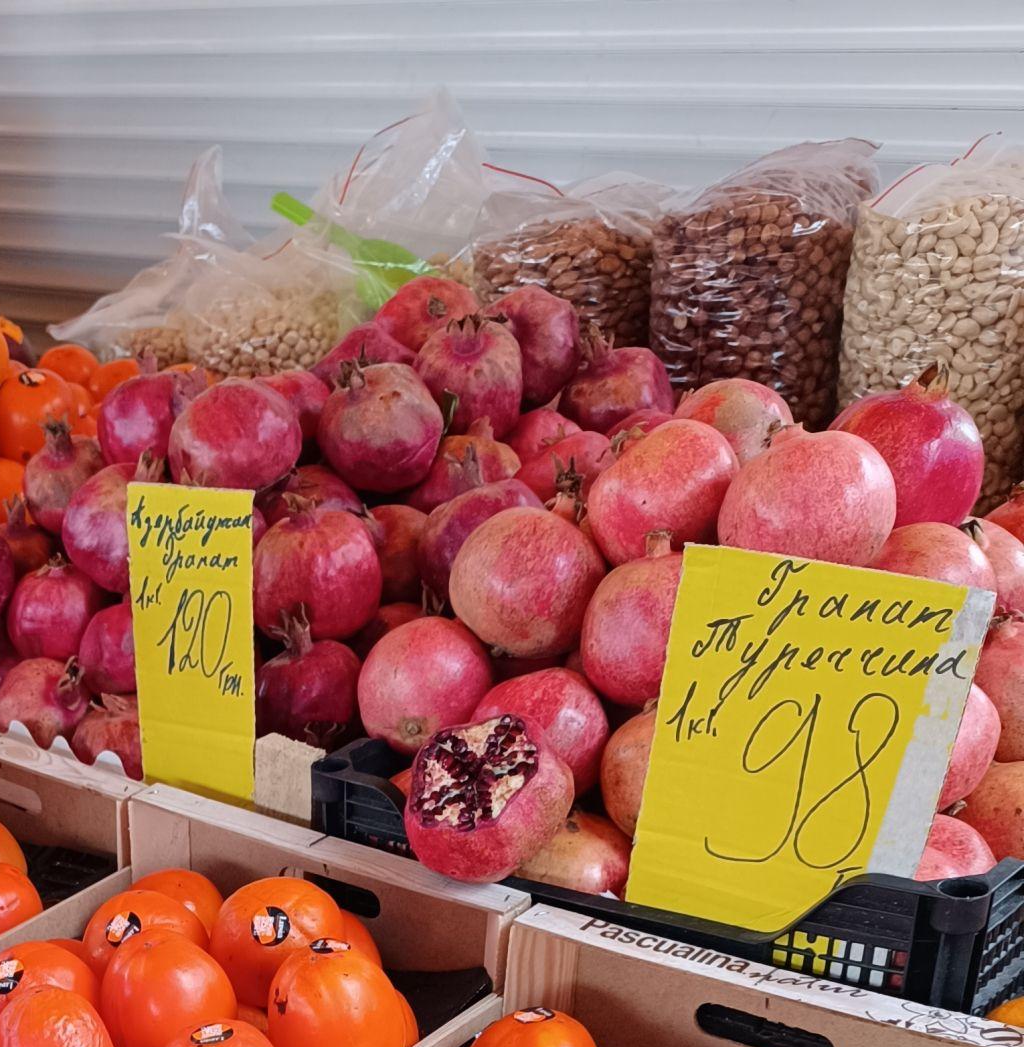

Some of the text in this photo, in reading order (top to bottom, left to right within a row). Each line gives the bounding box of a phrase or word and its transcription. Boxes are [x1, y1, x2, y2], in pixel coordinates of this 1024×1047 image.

[156, 587, 233, 678] 120
[757, 559, 956, 636] Гранат
[691, 613, 969, 701] Туреччина
[704, 692, 900, 869] 98
